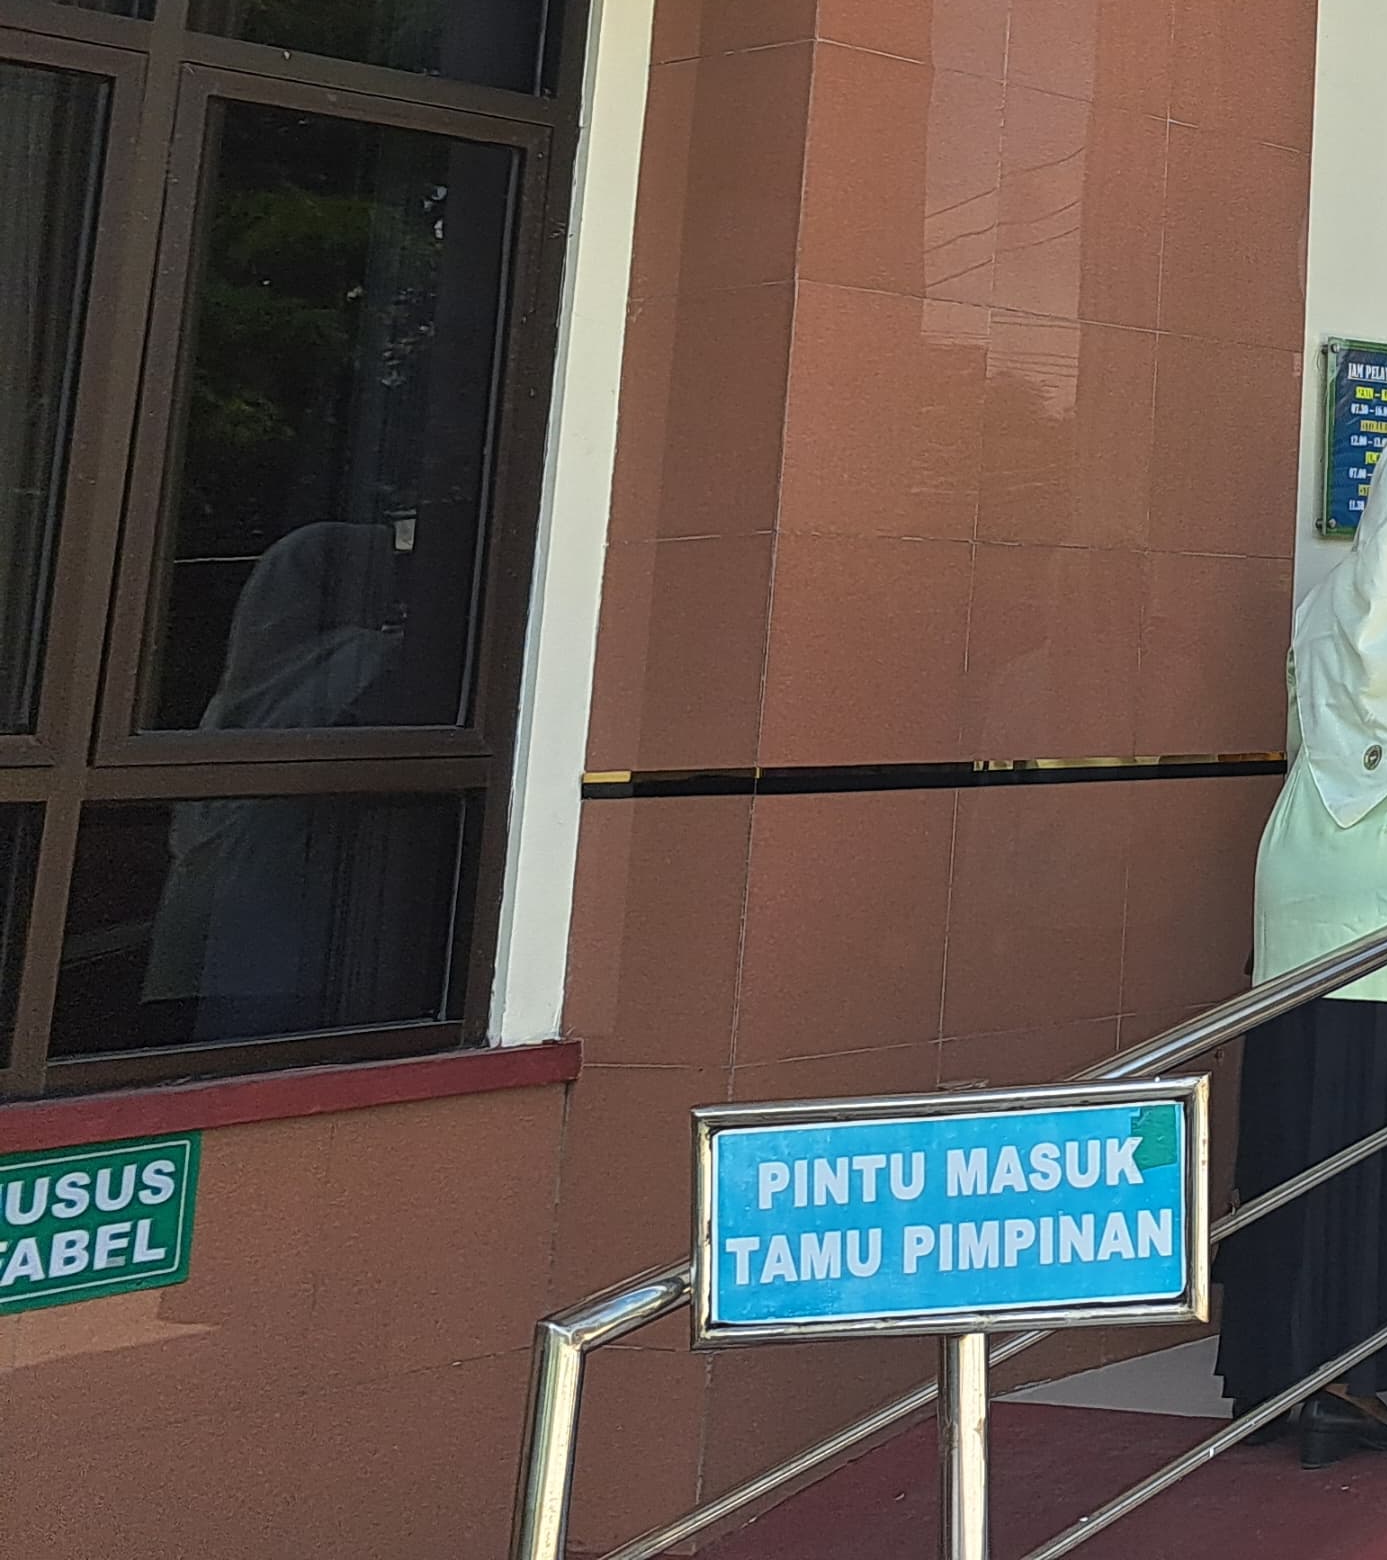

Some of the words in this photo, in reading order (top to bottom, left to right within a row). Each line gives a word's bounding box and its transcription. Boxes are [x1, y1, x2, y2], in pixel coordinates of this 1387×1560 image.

[1348, 363, 1364, 379] JAM
[0, 1159, 176, 1226] USUS
[757, 1150, 926, 1210] PINTU
[946, 1136, 1144, 1197] MASUK
[725, 1228, 882, 1285] TAMU
[903, 1208, 1173, 1274] PIMPINAN
